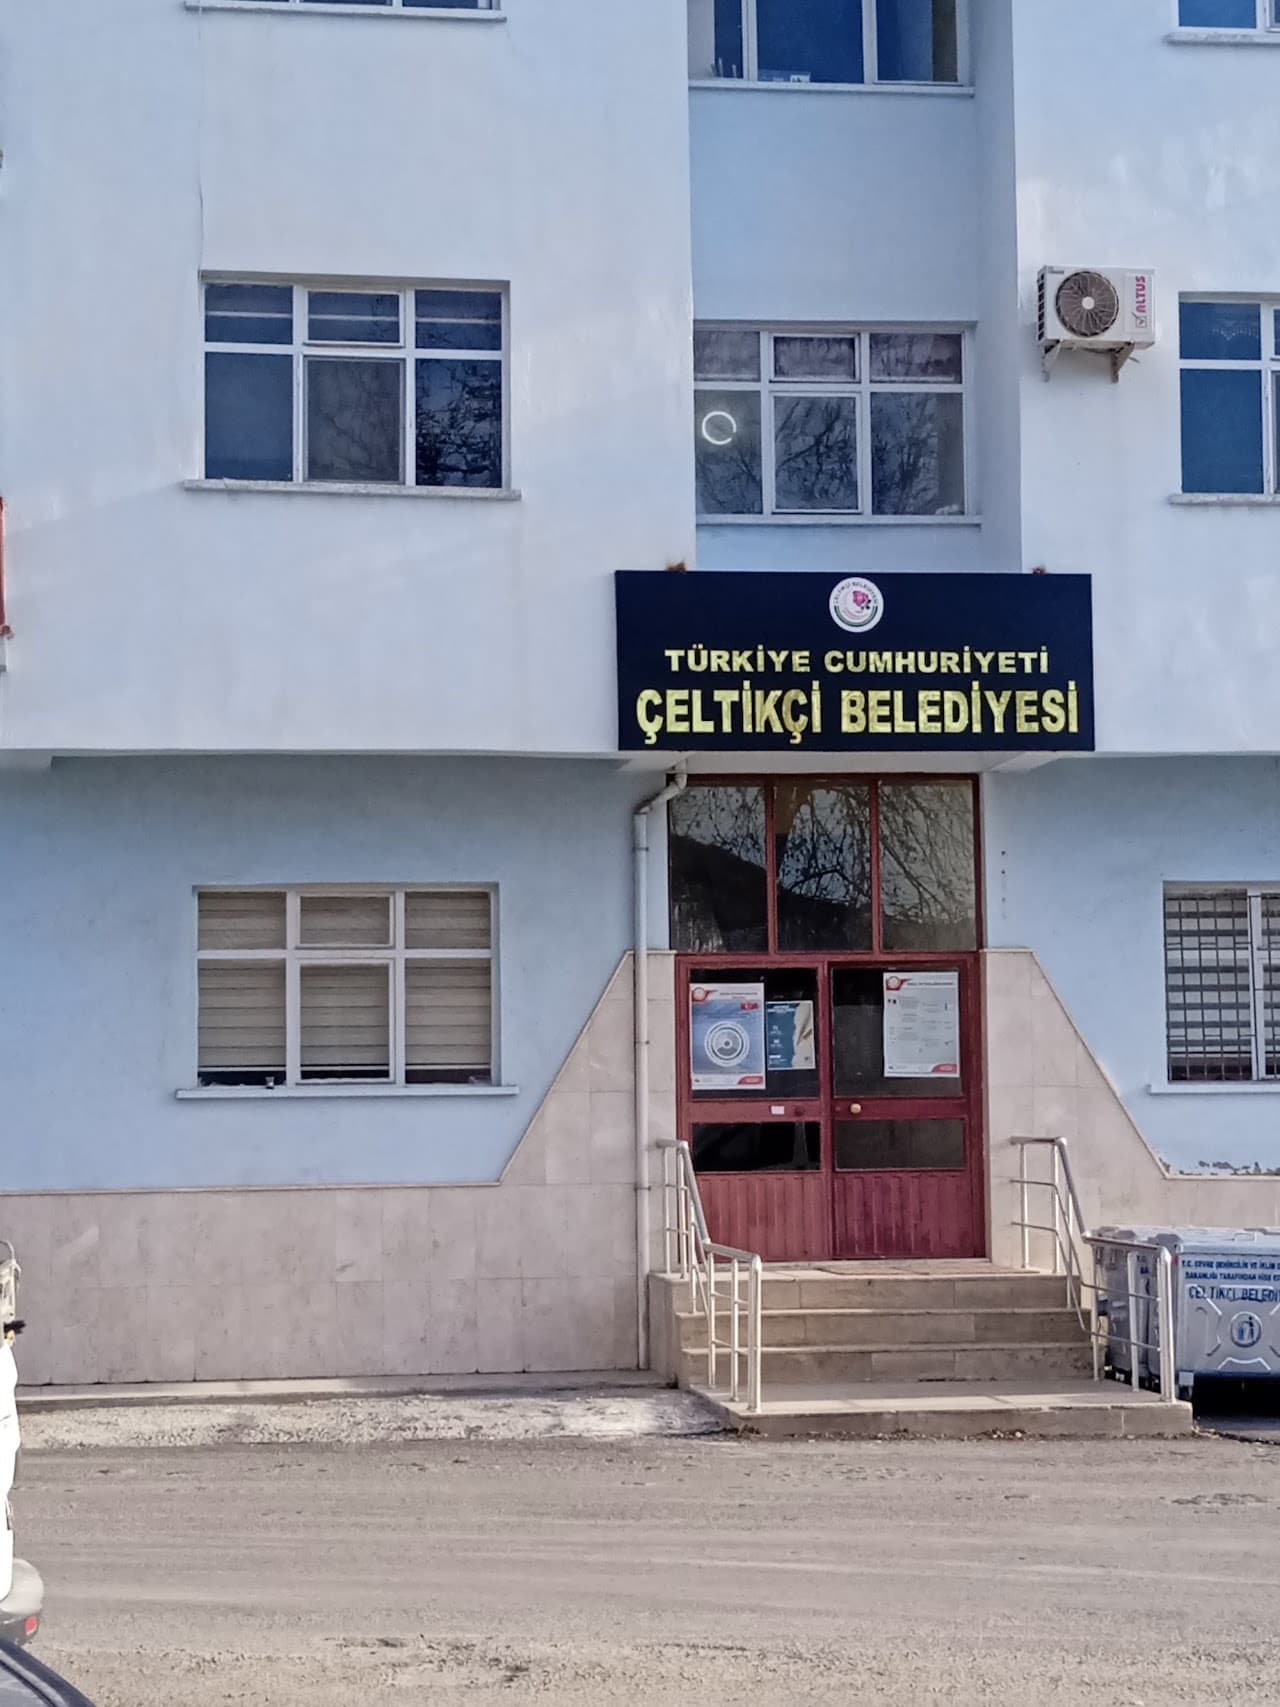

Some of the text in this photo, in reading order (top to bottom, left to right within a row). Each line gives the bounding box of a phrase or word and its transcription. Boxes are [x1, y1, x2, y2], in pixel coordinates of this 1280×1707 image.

[1135, 275, 1146, 313] ALTUS
[664, 643, 1049, 674] TÜRKİYE CUMHURİYETİ
[636, 680, 1079, 744] ÇELTİKÇİ BELEDİYESİ
